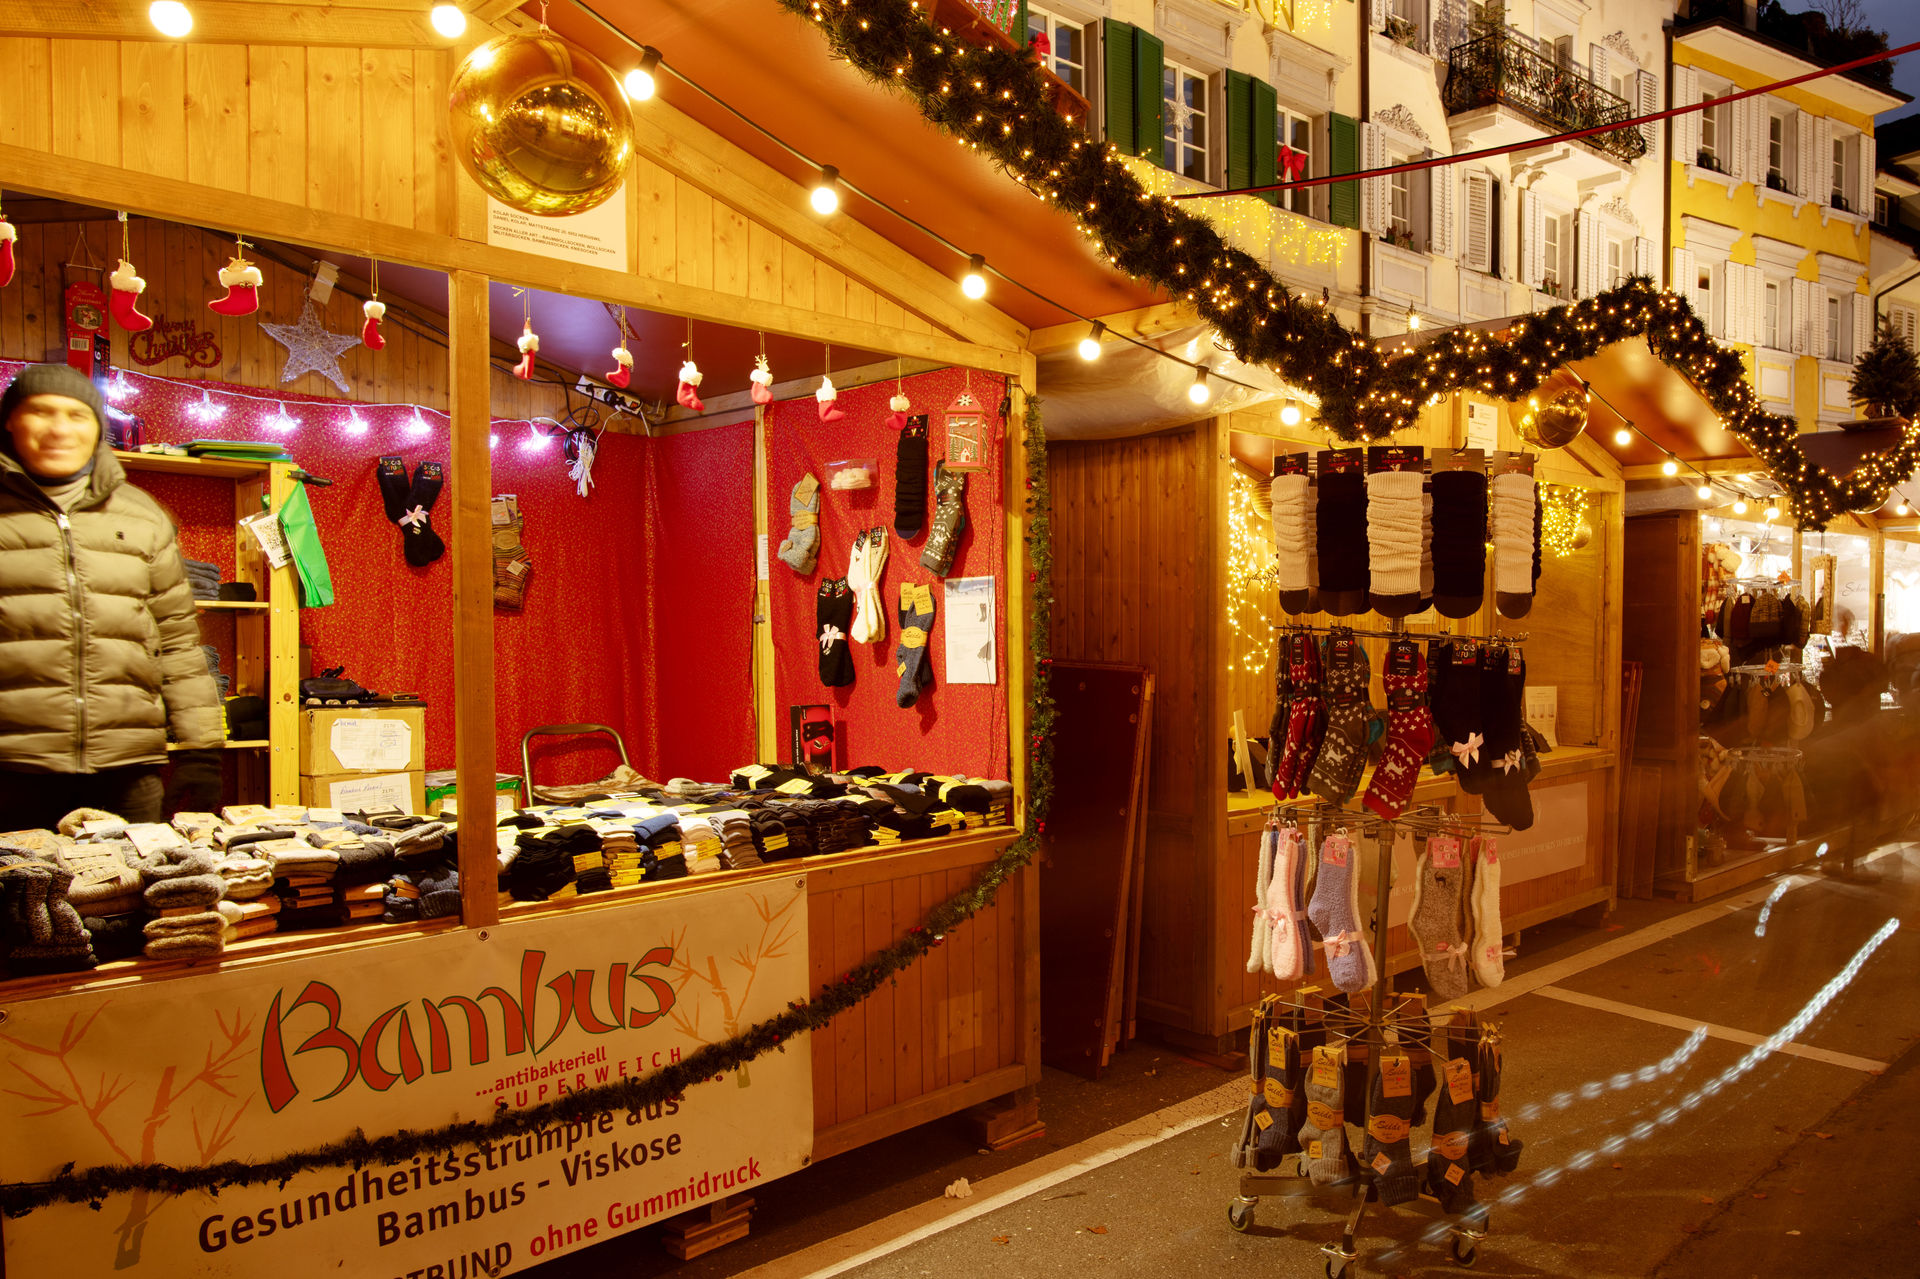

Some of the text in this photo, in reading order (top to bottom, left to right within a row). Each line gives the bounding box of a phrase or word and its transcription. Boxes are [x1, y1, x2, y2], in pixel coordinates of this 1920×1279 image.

[260, 947, 677, 1114] Bambus
[376, 1181, 526, 1248] Bambus
[560, 1132, 683, 1188] Viskose
[528, 1217, 599, 1257] ohne
[607, 1157, 763, 1230] Gummidruck
